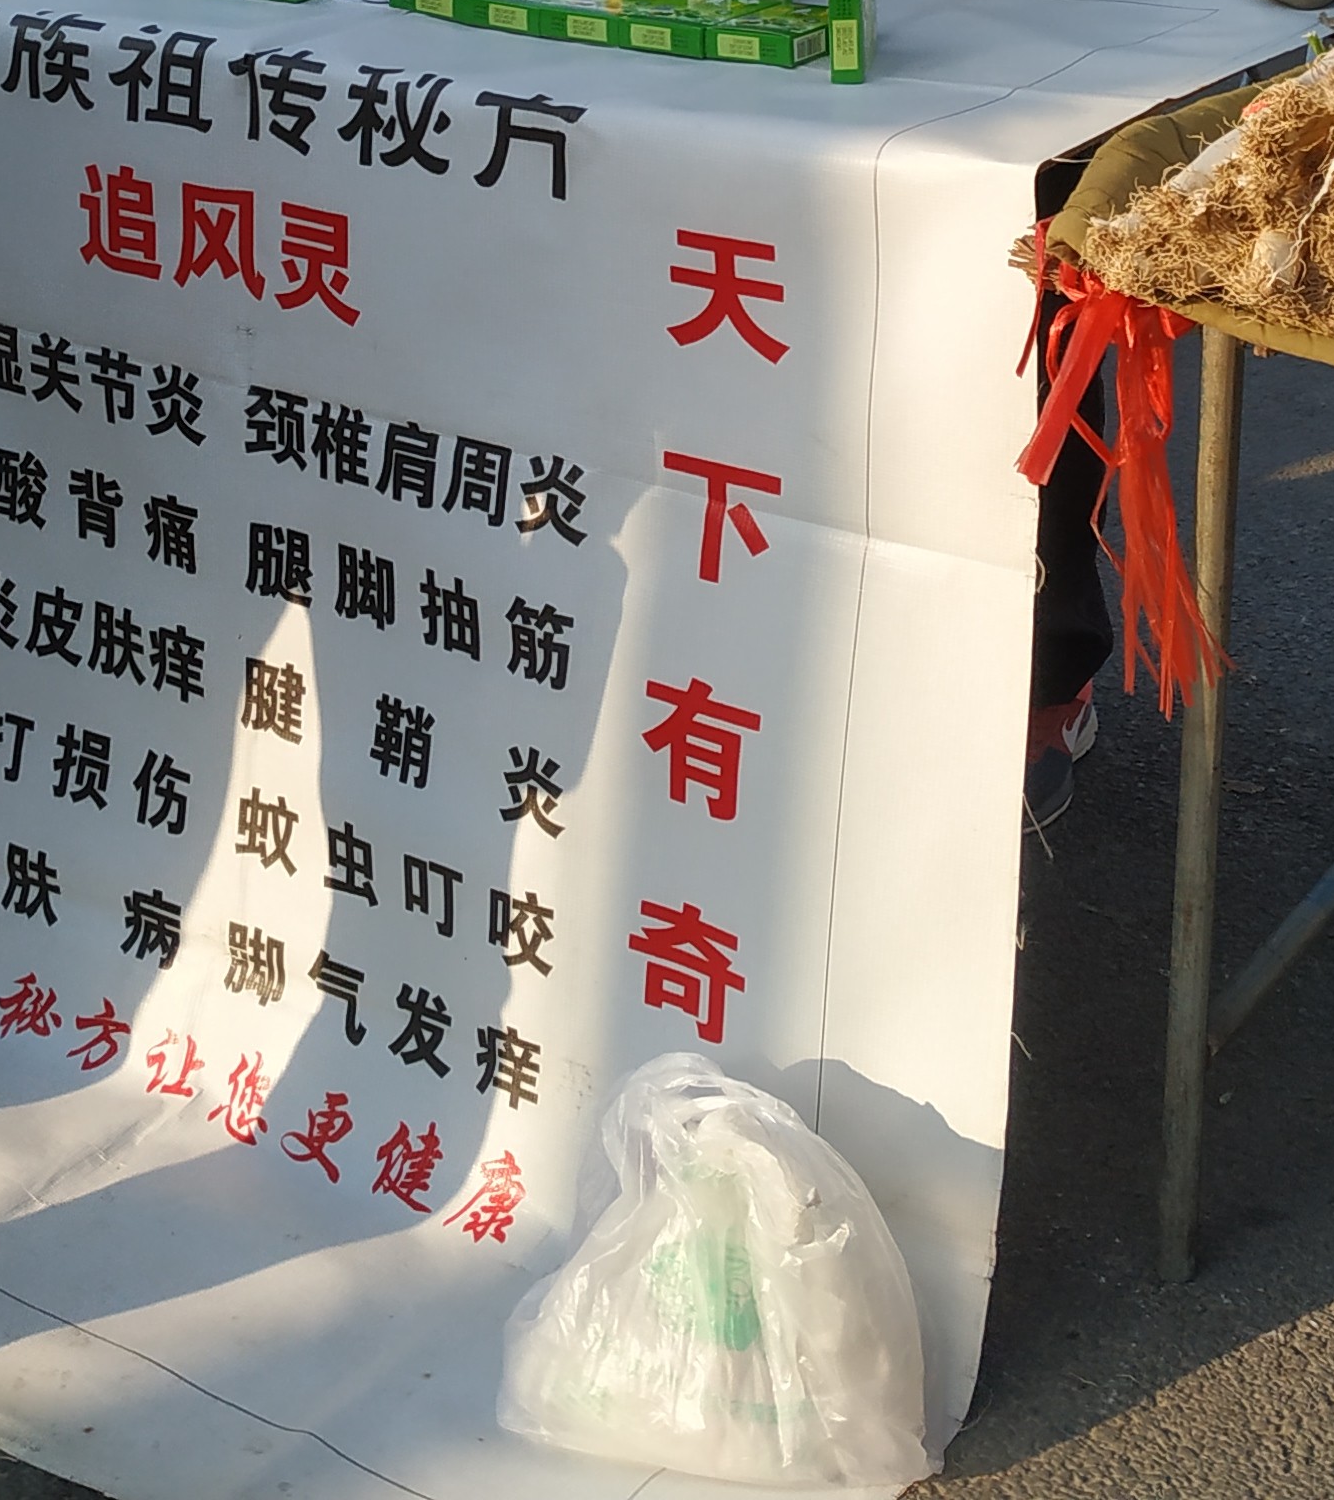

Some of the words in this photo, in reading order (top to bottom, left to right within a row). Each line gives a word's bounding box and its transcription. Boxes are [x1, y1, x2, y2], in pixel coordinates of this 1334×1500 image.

[78, 163, 361, 327] 追风灵
[244, 383, 589, 546] 颈椎肩周炎
[245, 520, 575, 691] 腿脚抽筋
[240, 656, 567, 841] 腱鞘炎
[234, 785, 556, 979] 蚊虫叮咬
[223, 920, 543, 1111] 脚气发痒
